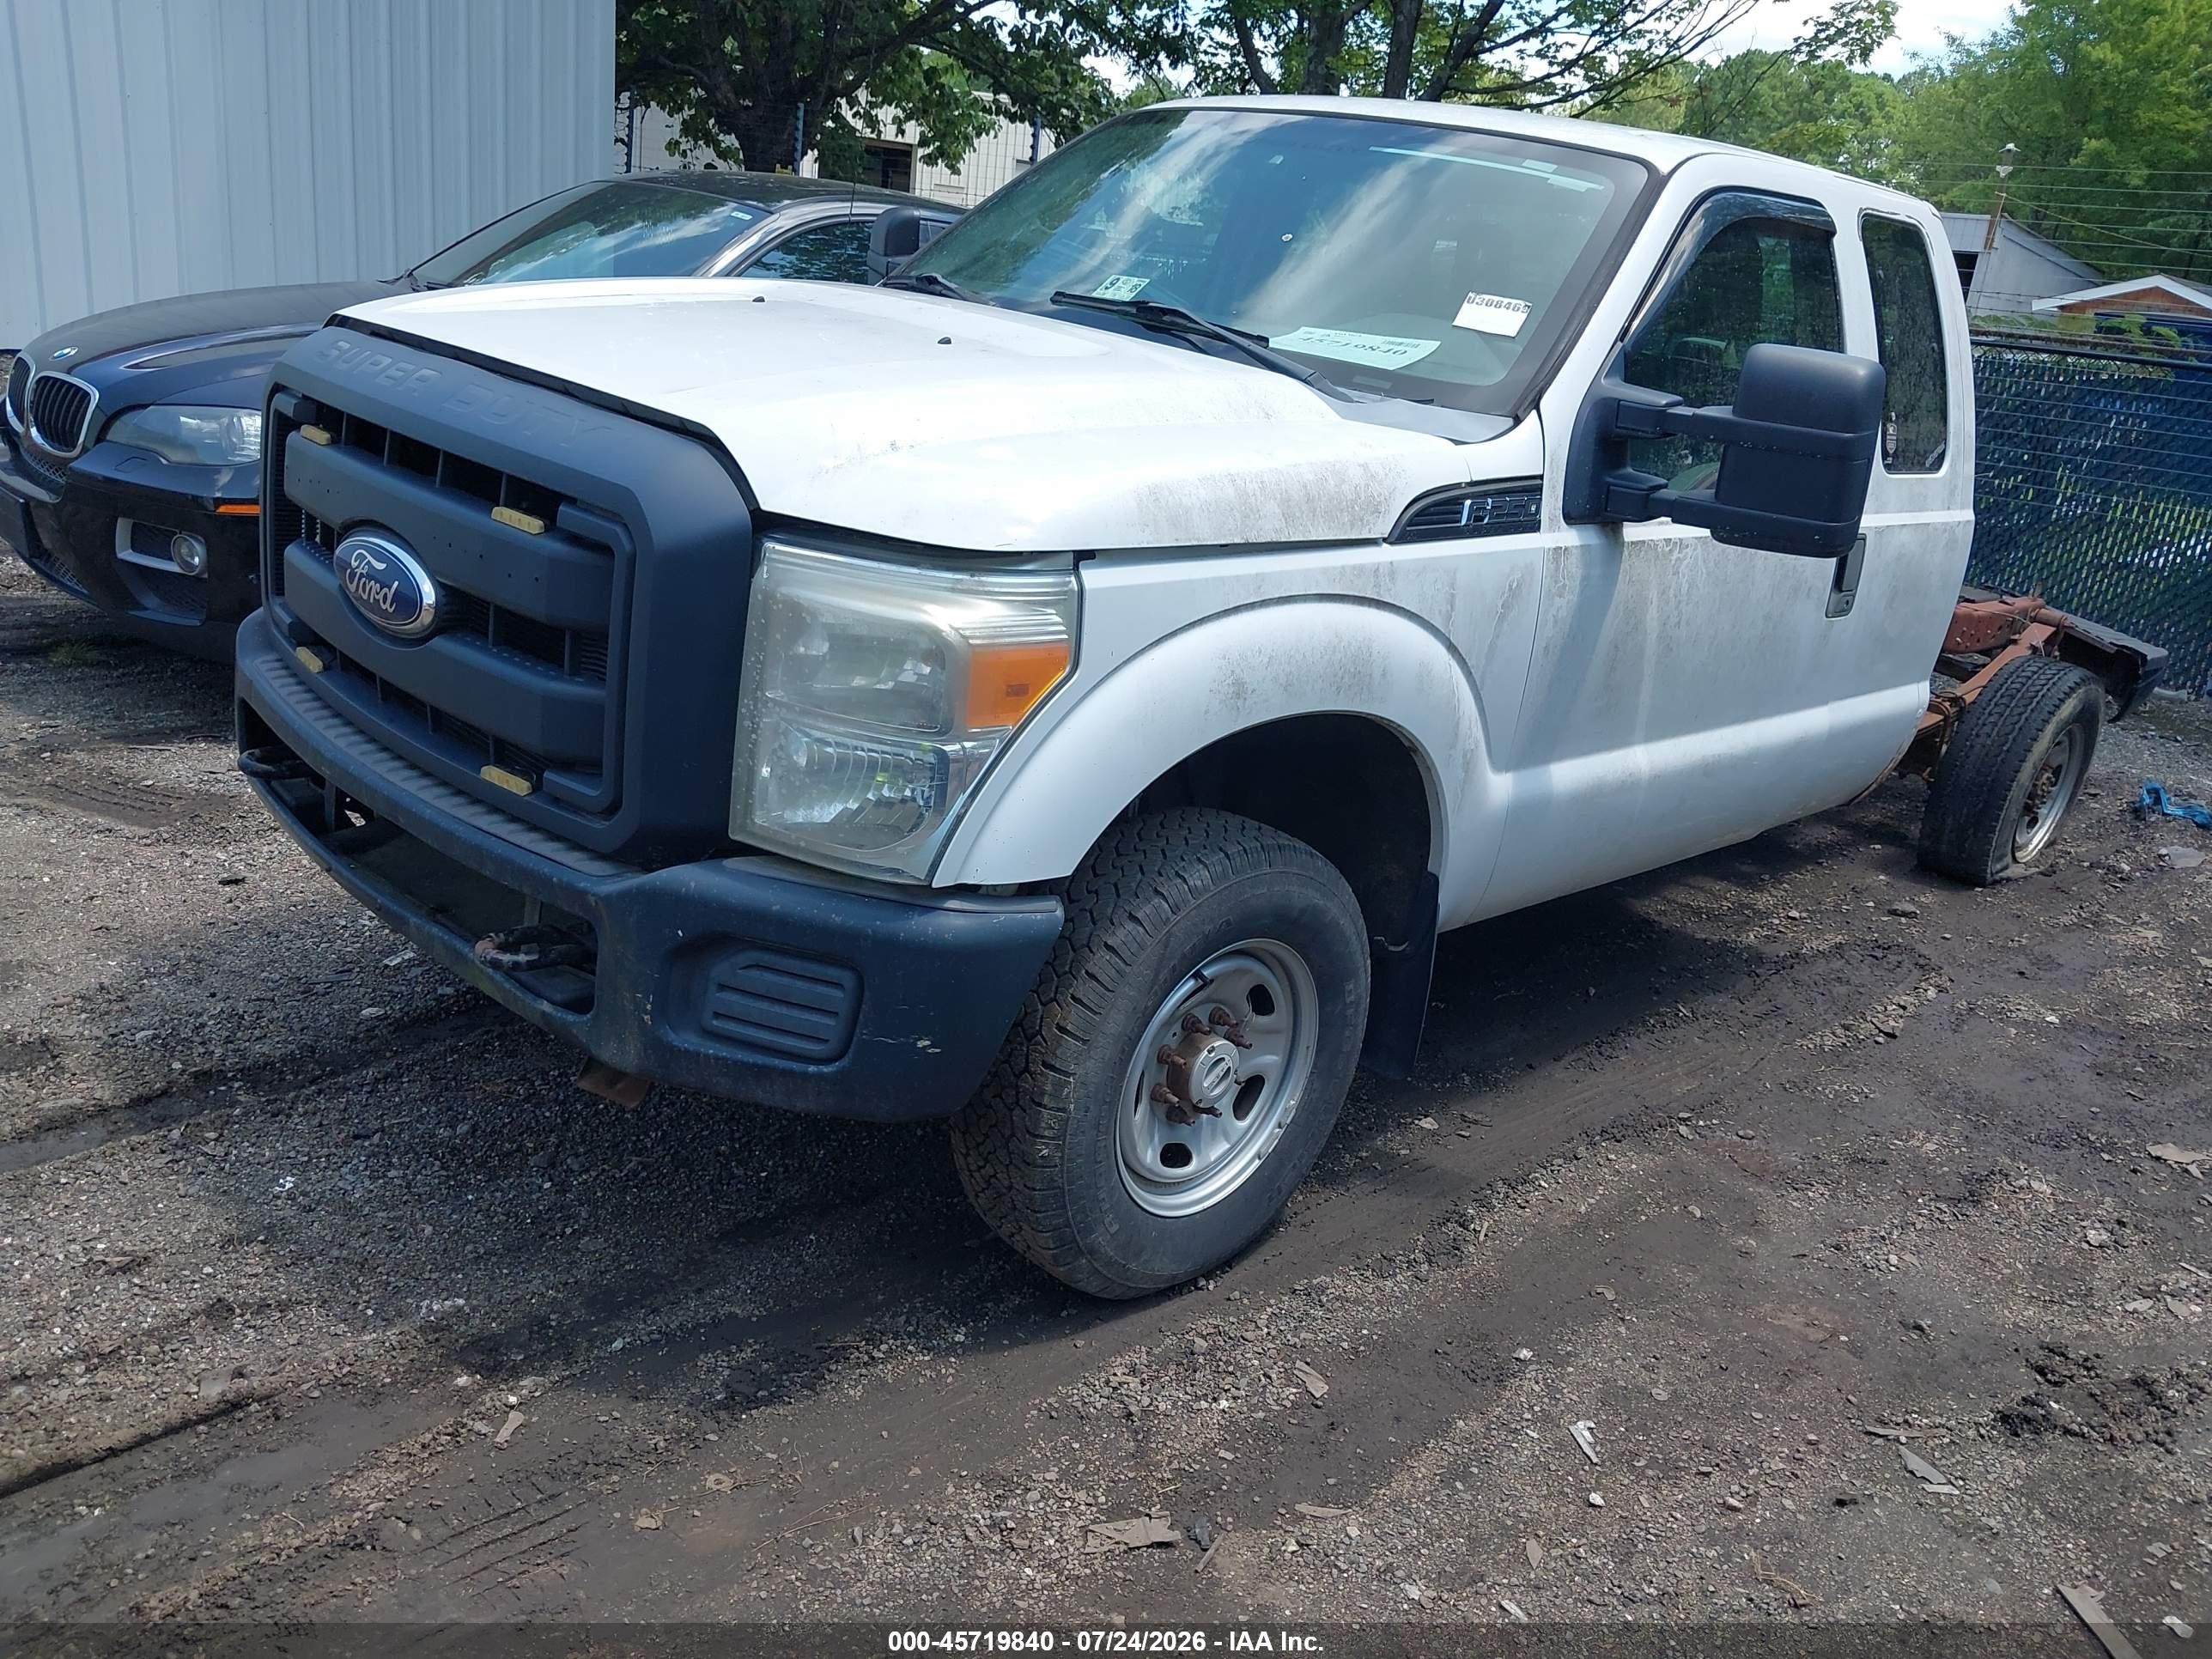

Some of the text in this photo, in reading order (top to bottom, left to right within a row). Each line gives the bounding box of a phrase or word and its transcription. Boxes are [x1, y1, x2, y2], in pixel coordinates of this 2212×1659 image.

[1104, 277, 1121, 290] 9
[315, 339, 617, 447] SUPER DUTY
[1461, 496, 1543, 526] F-250
[346, 549, 399, 613] Ford
